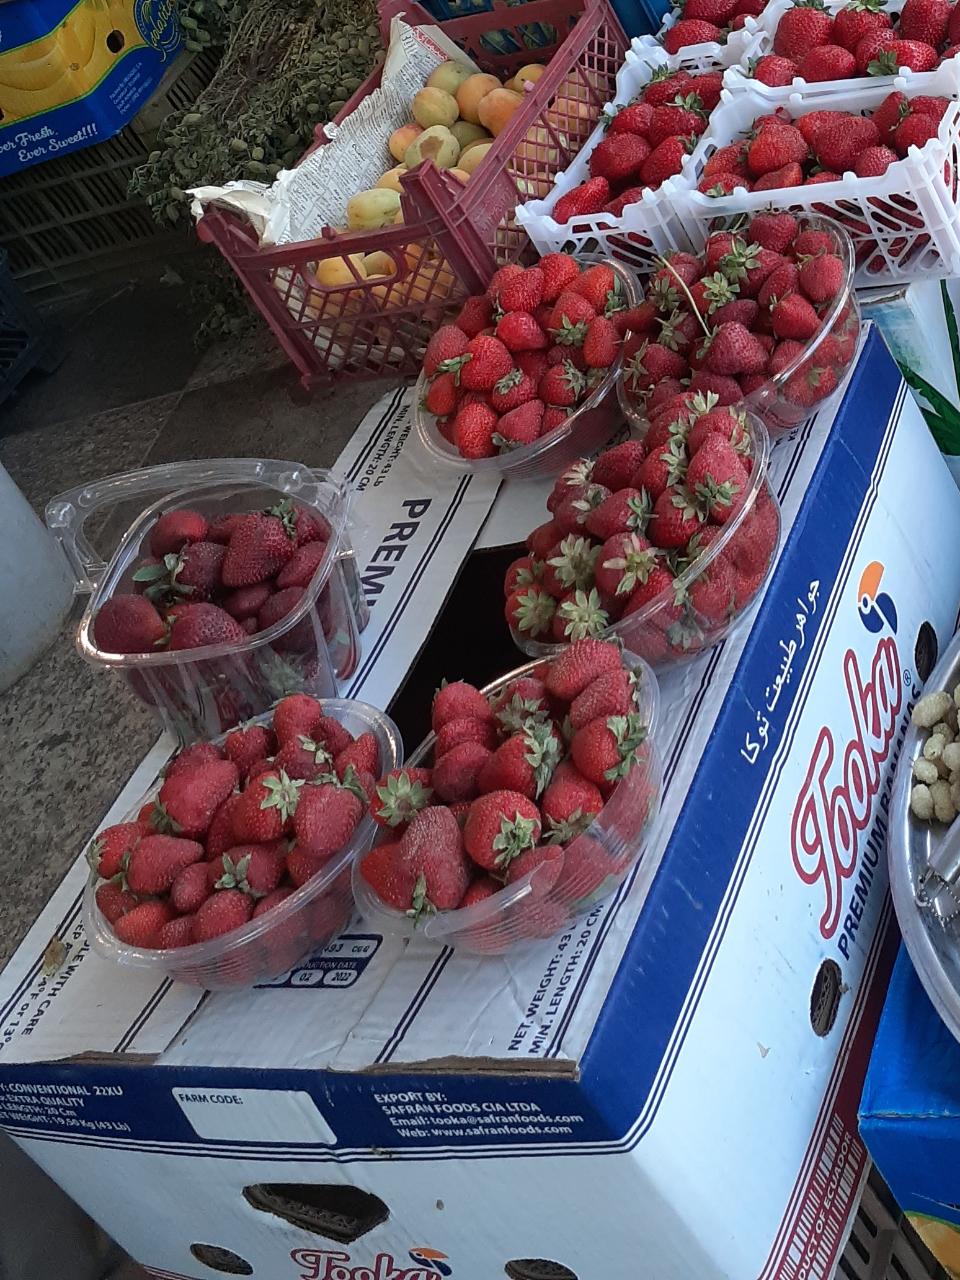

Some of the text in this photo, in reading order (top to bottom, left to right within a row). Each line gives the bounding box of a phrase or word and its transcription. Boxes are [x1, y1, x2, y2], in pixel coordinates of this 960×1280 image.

[18, 123, 98, 162] Ever Sweet!!!
[374, 425, 399, 466] LENGTH:
[361, 498, 432, 607] PREM
[740, 580, 820, 764] جواهر طبیعت توکا
[791, 636, 902, 939] Tooka
[837, 813, 888, 961] PREMIUM
[299, 972, 313, 981] 02
[331, 972, 352, 982] 2022
[338, 961, 357, 969] DATE
[526, 953, 564, 1018] WEIGHT:
[559, 934, 572, 952] 43
[21, 964, 80, 1036] WITH CARE
[528, 1018, 553, 1053] MIN.
[546, 950, 583, 1016] LENGTH:
[577, 929, 591, 949] 20
[6, 1094, 42, 1106] EXTRA
[42, 1097, 86, 1108] QUALITY
[8, 1083, 92, 1097] CONVENTIONAL
[94, 1086, 124, 1096] 22XU
[178, 1093, 243, 1105] FARM CODE:
[374, 1091, 448, 1104] EXPORT BY:
[382, 1102, 541, 1115] SAFRAN FOODS CIA LTDA
[389, 1113, 584, 1126] Email: tooka@safranfoods.com
[396, 1125, 573, 1138] Web: www.safranfoods.com
[815, 1208, 827, 1234] OF
[823, 1131, 853, 1210] ECUADOR
